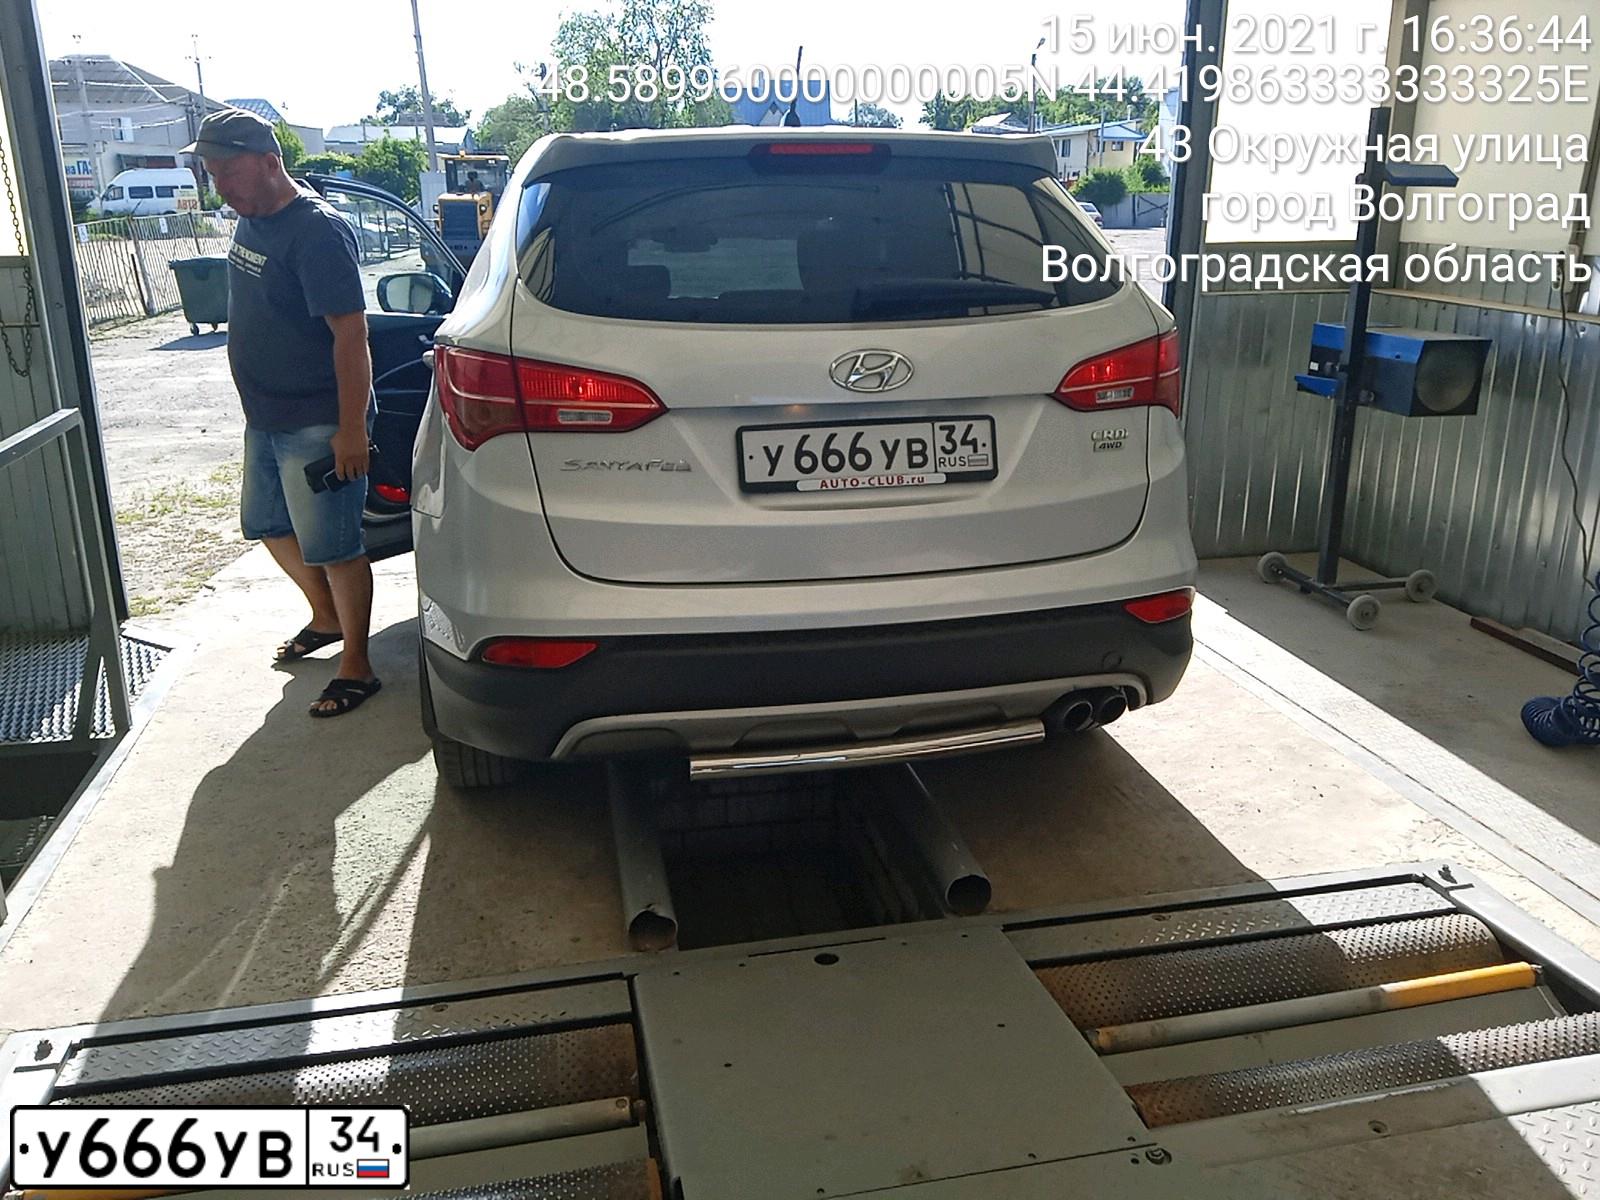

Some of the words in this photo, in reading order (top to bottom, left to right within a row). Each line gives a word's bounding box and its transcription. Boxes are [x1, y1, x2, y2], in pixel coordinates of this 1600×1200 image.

[938, 423, 979, 455] 34
[938, 456, 967, 469] RUS
[819, 473, 925, 490] AUTO-CLUB.ru
